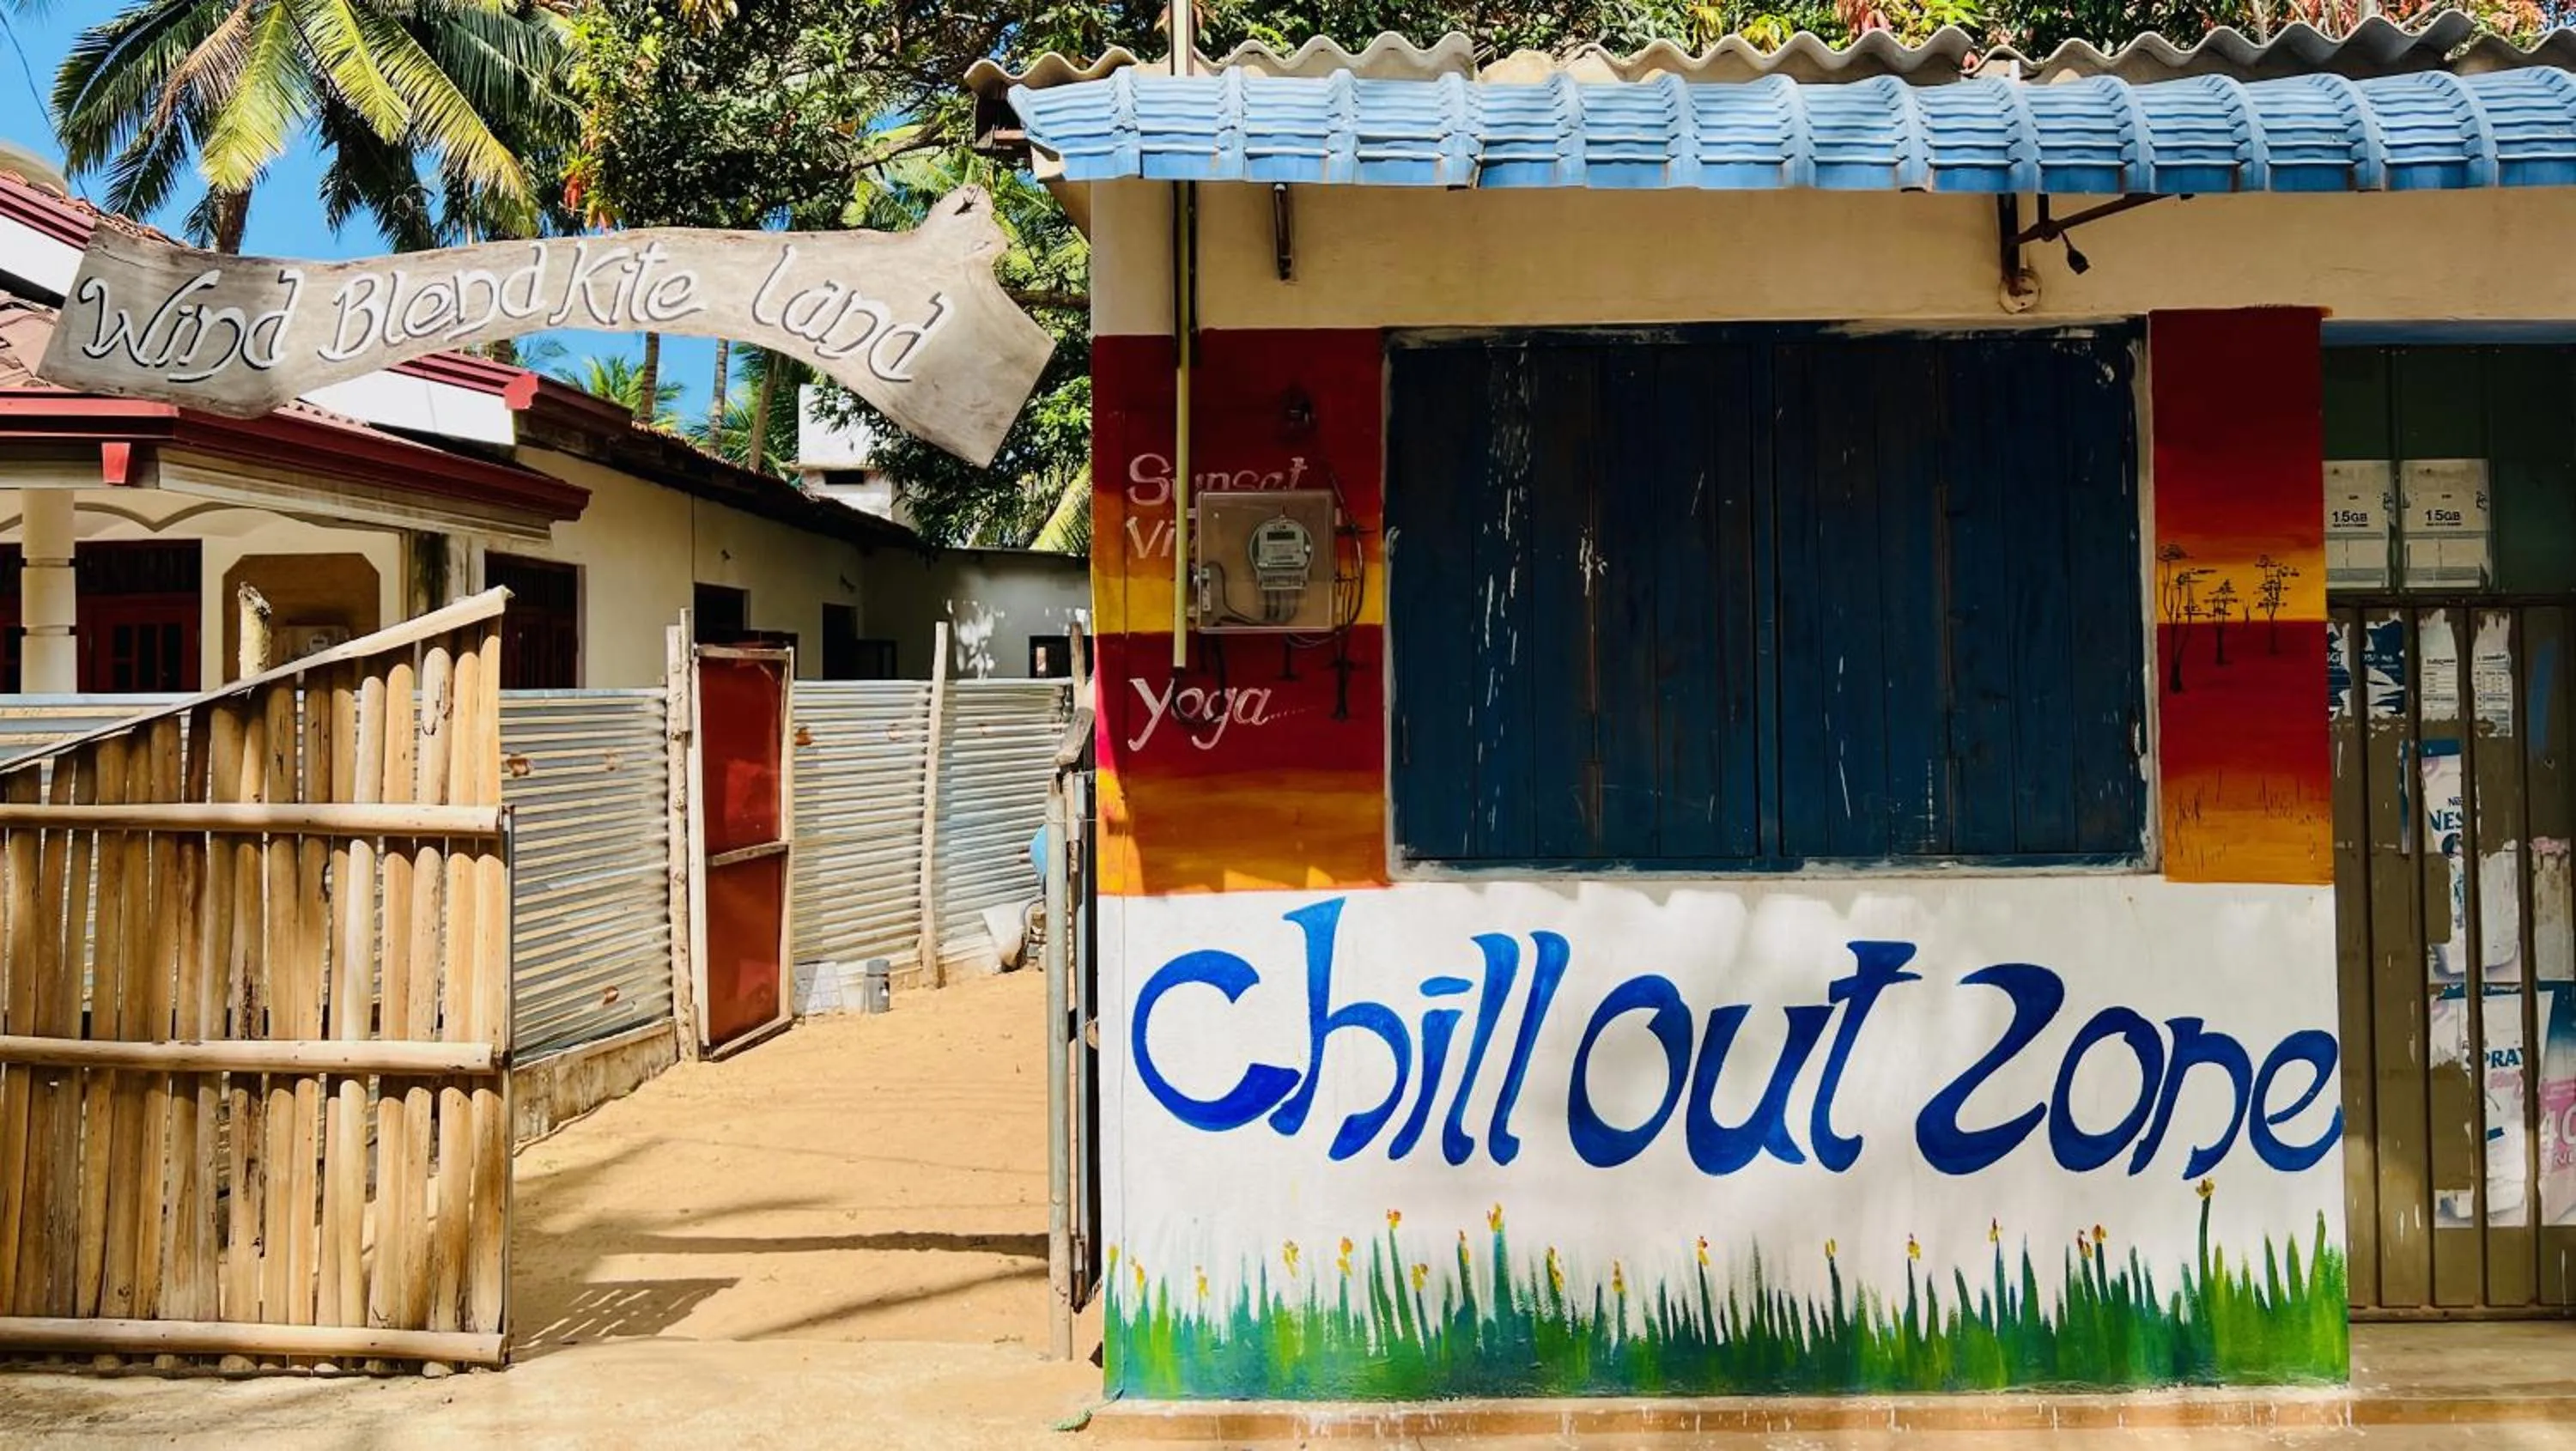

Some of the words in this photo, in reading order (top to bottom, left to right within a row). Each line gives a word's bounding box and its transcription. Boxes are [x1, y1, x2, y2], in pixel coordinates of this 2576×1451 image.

[78, 270, 304, 383] Wind
[318, 241, 547, 361] Blend
[548, 240, 706, 326] Kite
